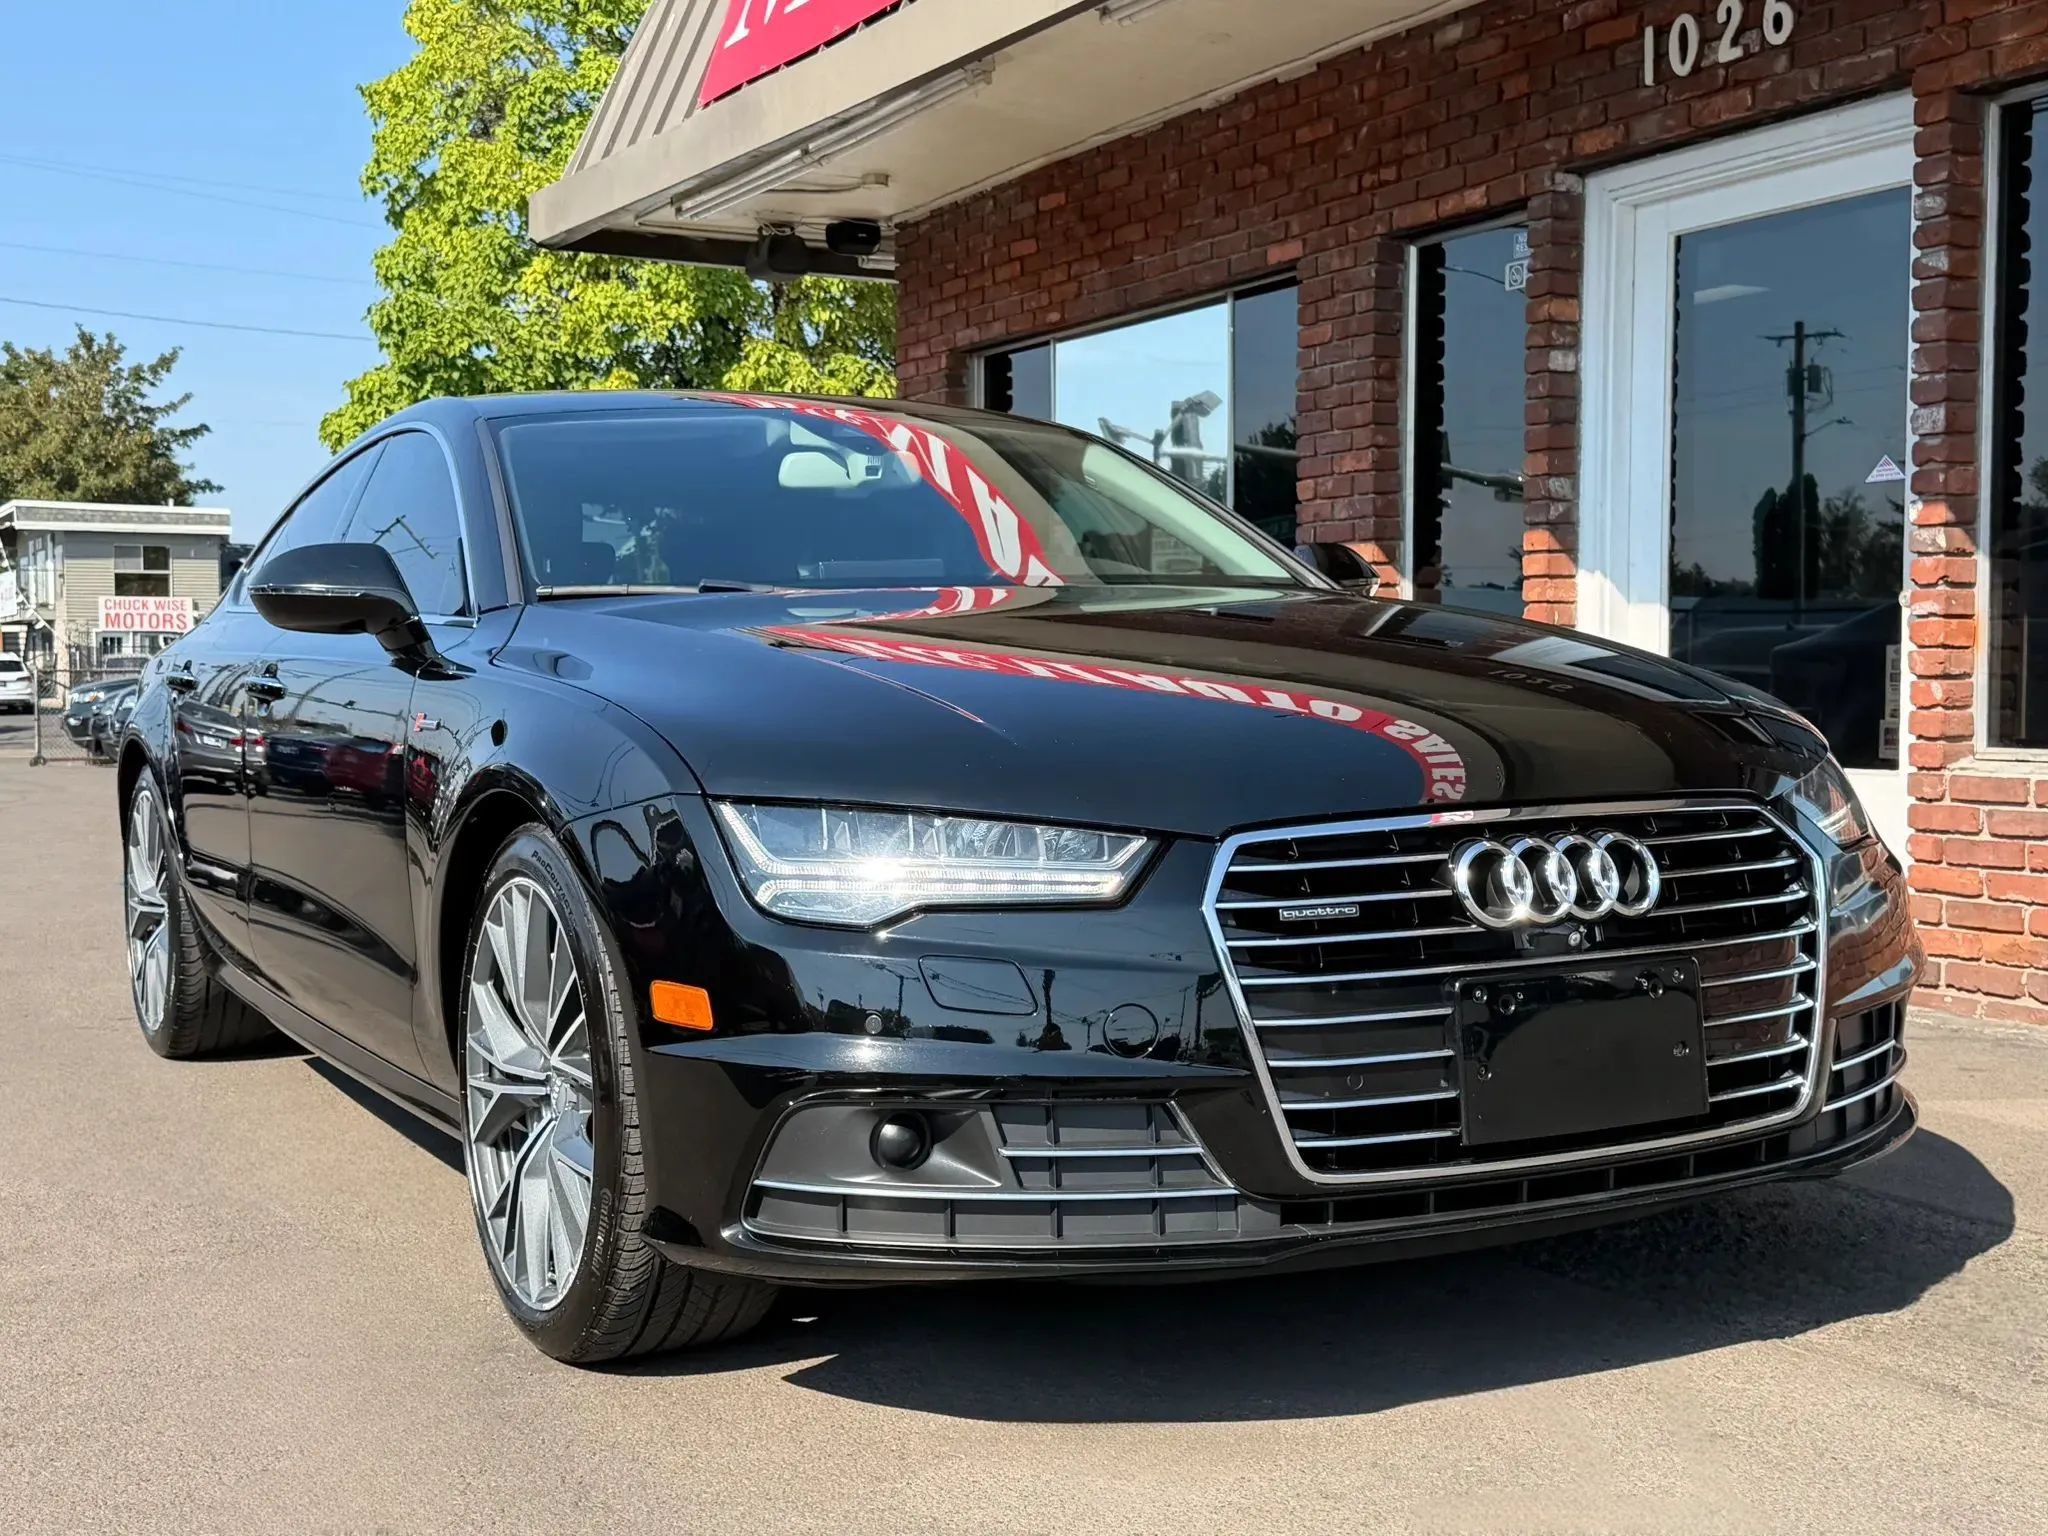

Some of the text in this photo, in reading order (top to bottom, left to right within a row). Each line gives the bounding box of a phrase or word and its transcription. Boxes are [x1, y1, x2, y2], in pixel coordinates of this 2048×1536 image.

[1643, 0, 1795, 87] 1026
[104, 598, 188, 612] CHUCK WISE
[105, 612, 188, 631] MOTORS
[1282, 907, 1356, 919] quattro
